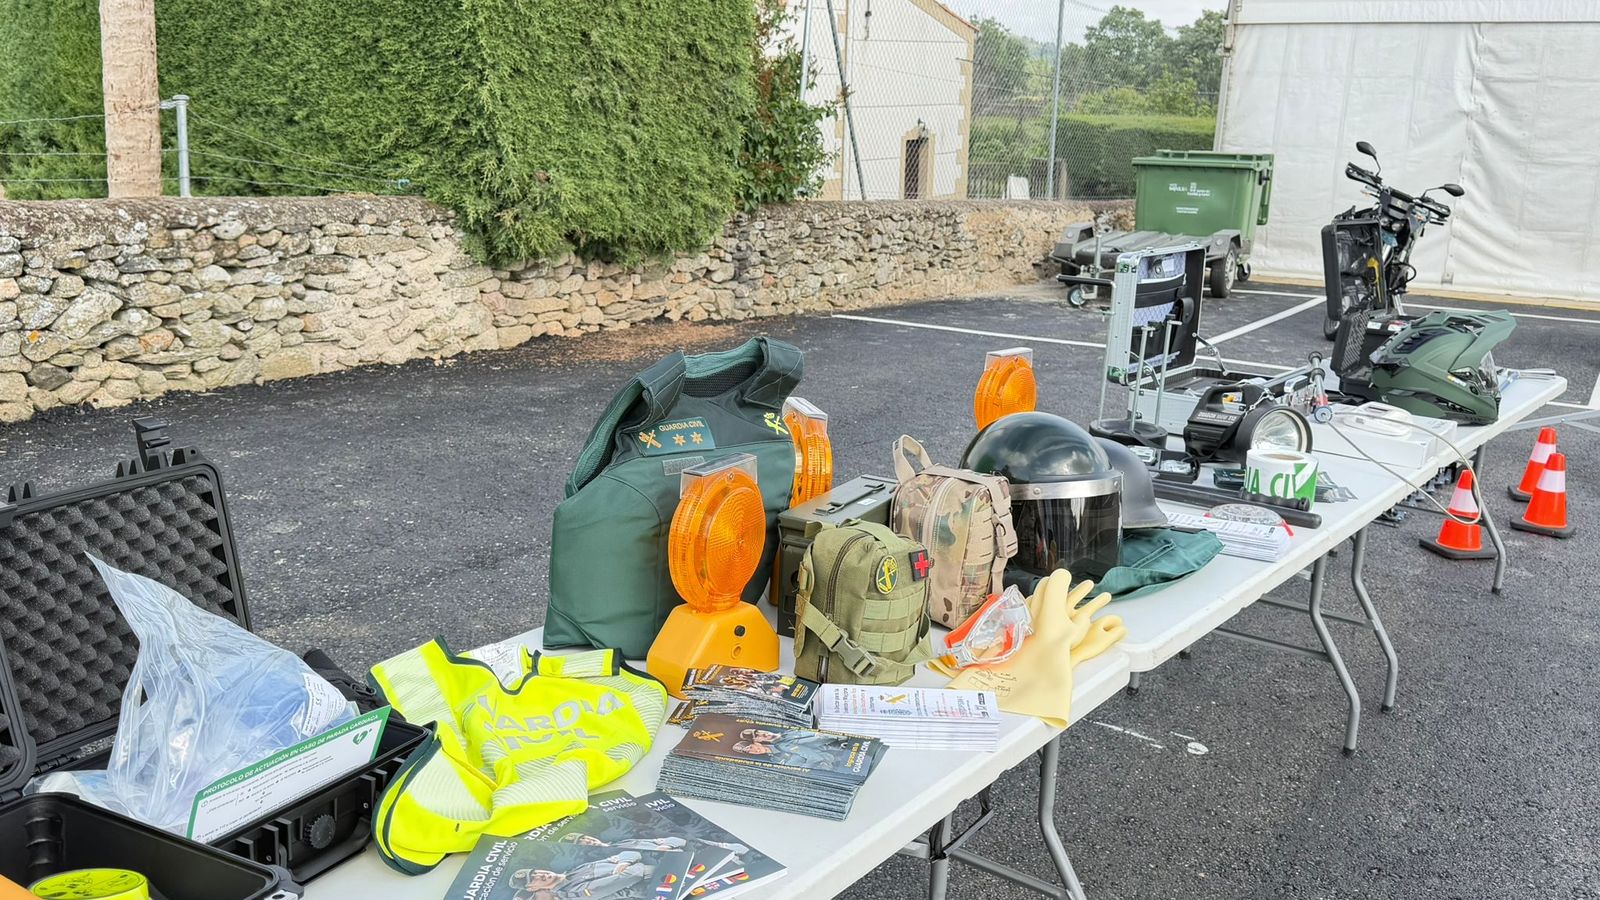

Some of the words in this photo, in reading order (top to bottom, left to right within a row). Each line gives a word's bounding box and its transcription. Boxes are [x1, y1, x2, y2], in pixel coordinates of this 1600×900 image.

[659, 422, 689, 431] GUARDIA
[688, 420, 705, 428] CIVIL
[477, 691, 625, 734] ARDIA
[202, 774, 244, 797] PROTOCOLO
[253, 752, 290, 775] ACTUACIÓN
[299, 741, 317, 752] CASO
[326, 727, 350, 741] PARADA
[599, 796, 633, 807] CIVIL
[602, 801, 637, 813] servicio
[485, 840, 508, 863] CIVIL
[491, 866, 504, 877] de
[498, 841, 518, 867] servicio
